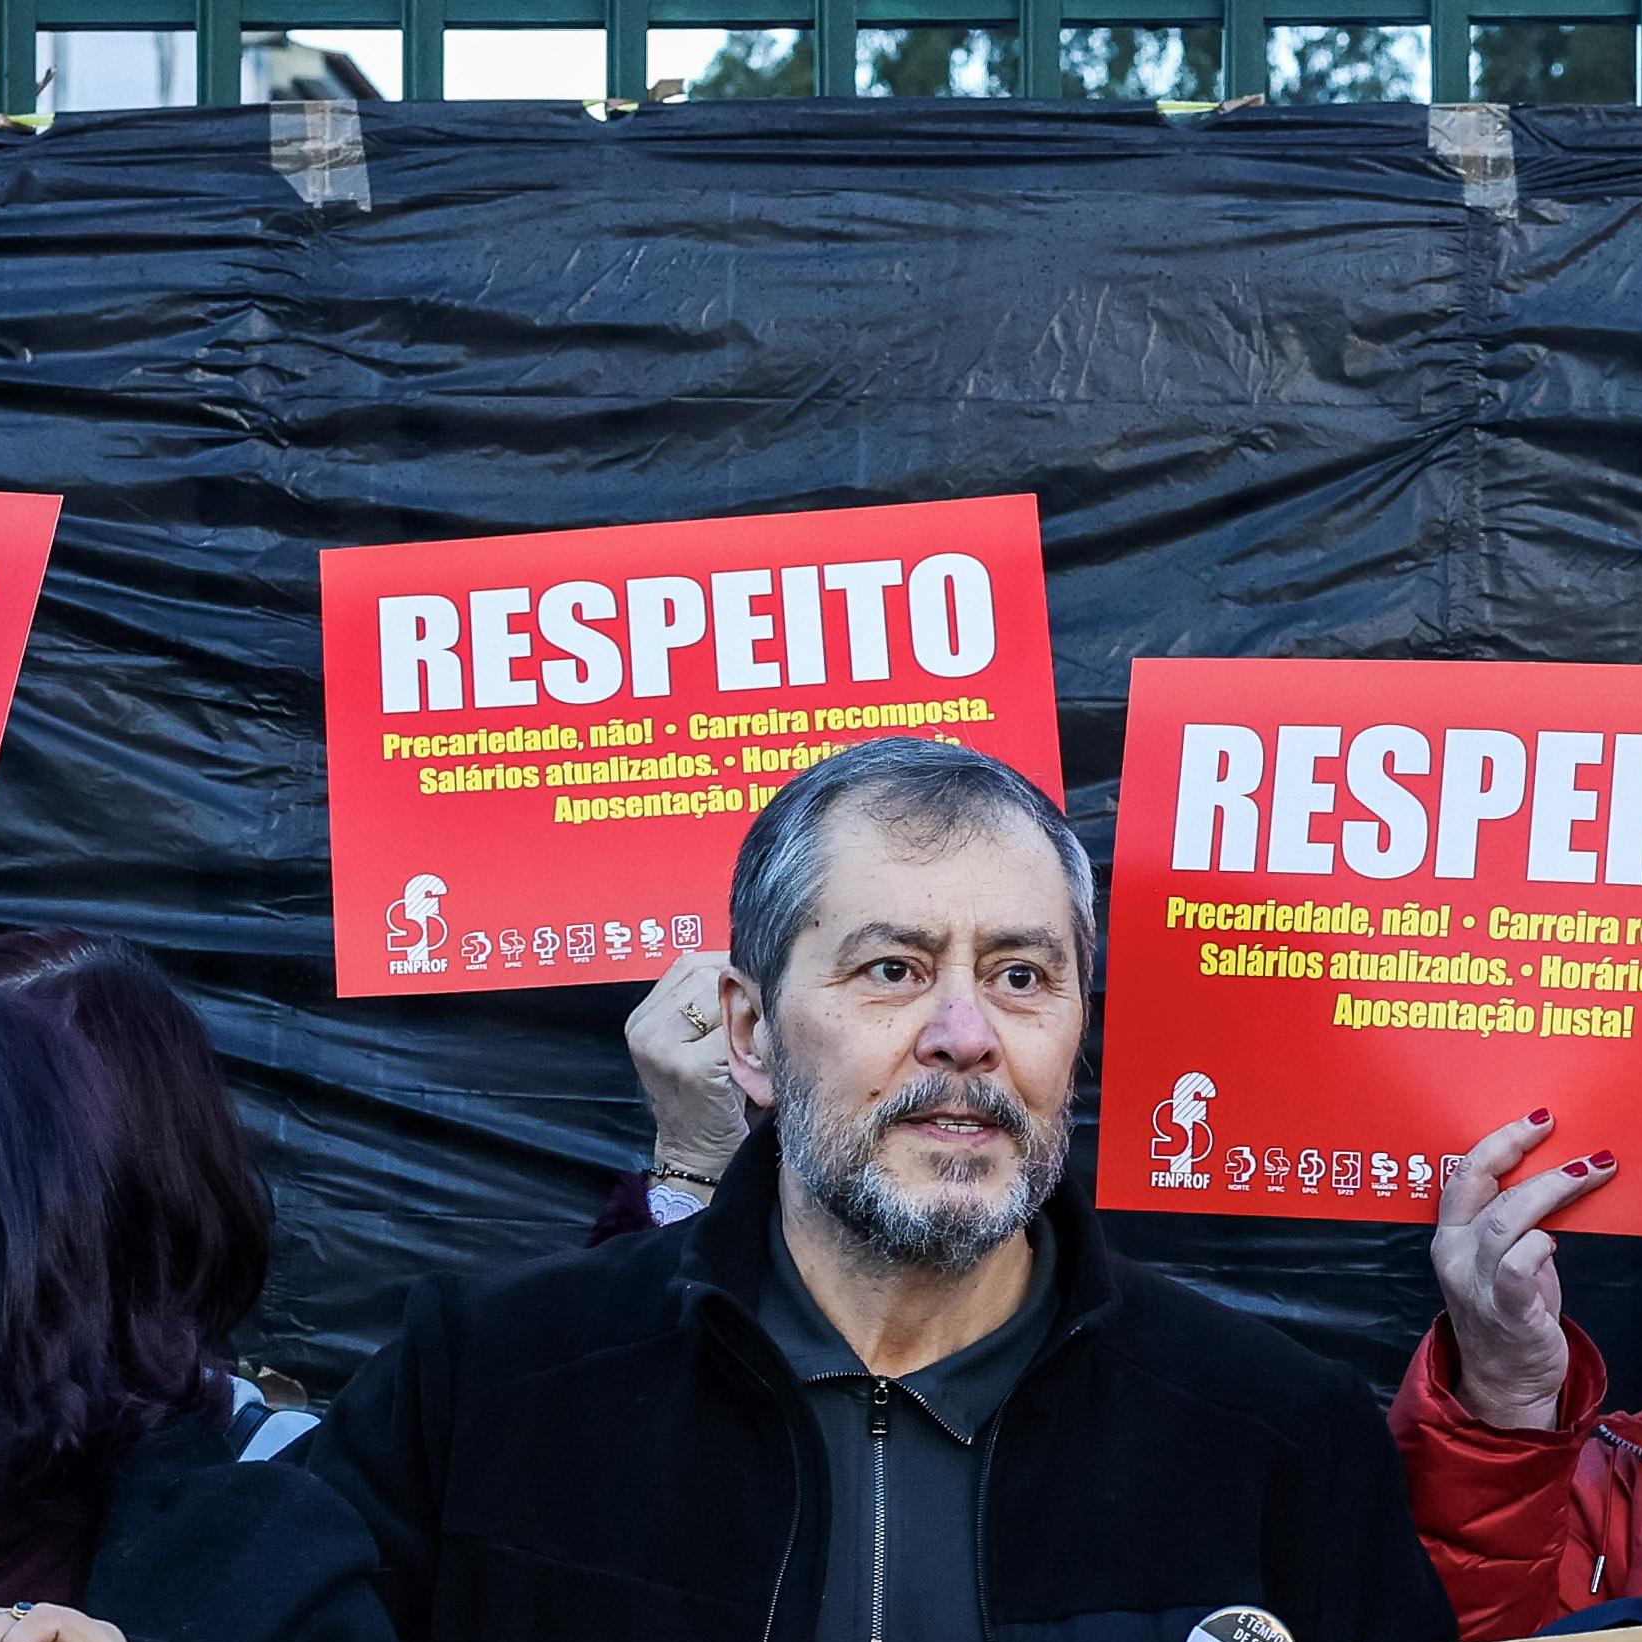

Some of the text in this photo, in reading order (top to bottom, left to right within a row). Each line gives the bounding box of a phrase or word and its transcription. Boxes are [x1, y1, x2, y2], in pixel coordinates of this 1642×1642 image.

[378, 551, 997, 714] RESPEITO
[382, 696, 996, 761] Precariedade, não! Carreira recomposta.
[419, 740, 849, 795] Salários atualizados. Horári
[554, 784, 744, 826] Aposentação
[1166, 896, 1376, 938] Precariedade,
[1381, 902, 1452, 937] não!
[1488, 906, 1621, 945] Carreira
[389, 958, 449, 975] FENPROF
[1199, 941, 1325, 980] Salários
[1328, 949, 1513, 987] atualizados.
[1332, 992, 1635, 1039] Aposentação justa!
[1150, 1171, 1211, 1189] FENPROF
